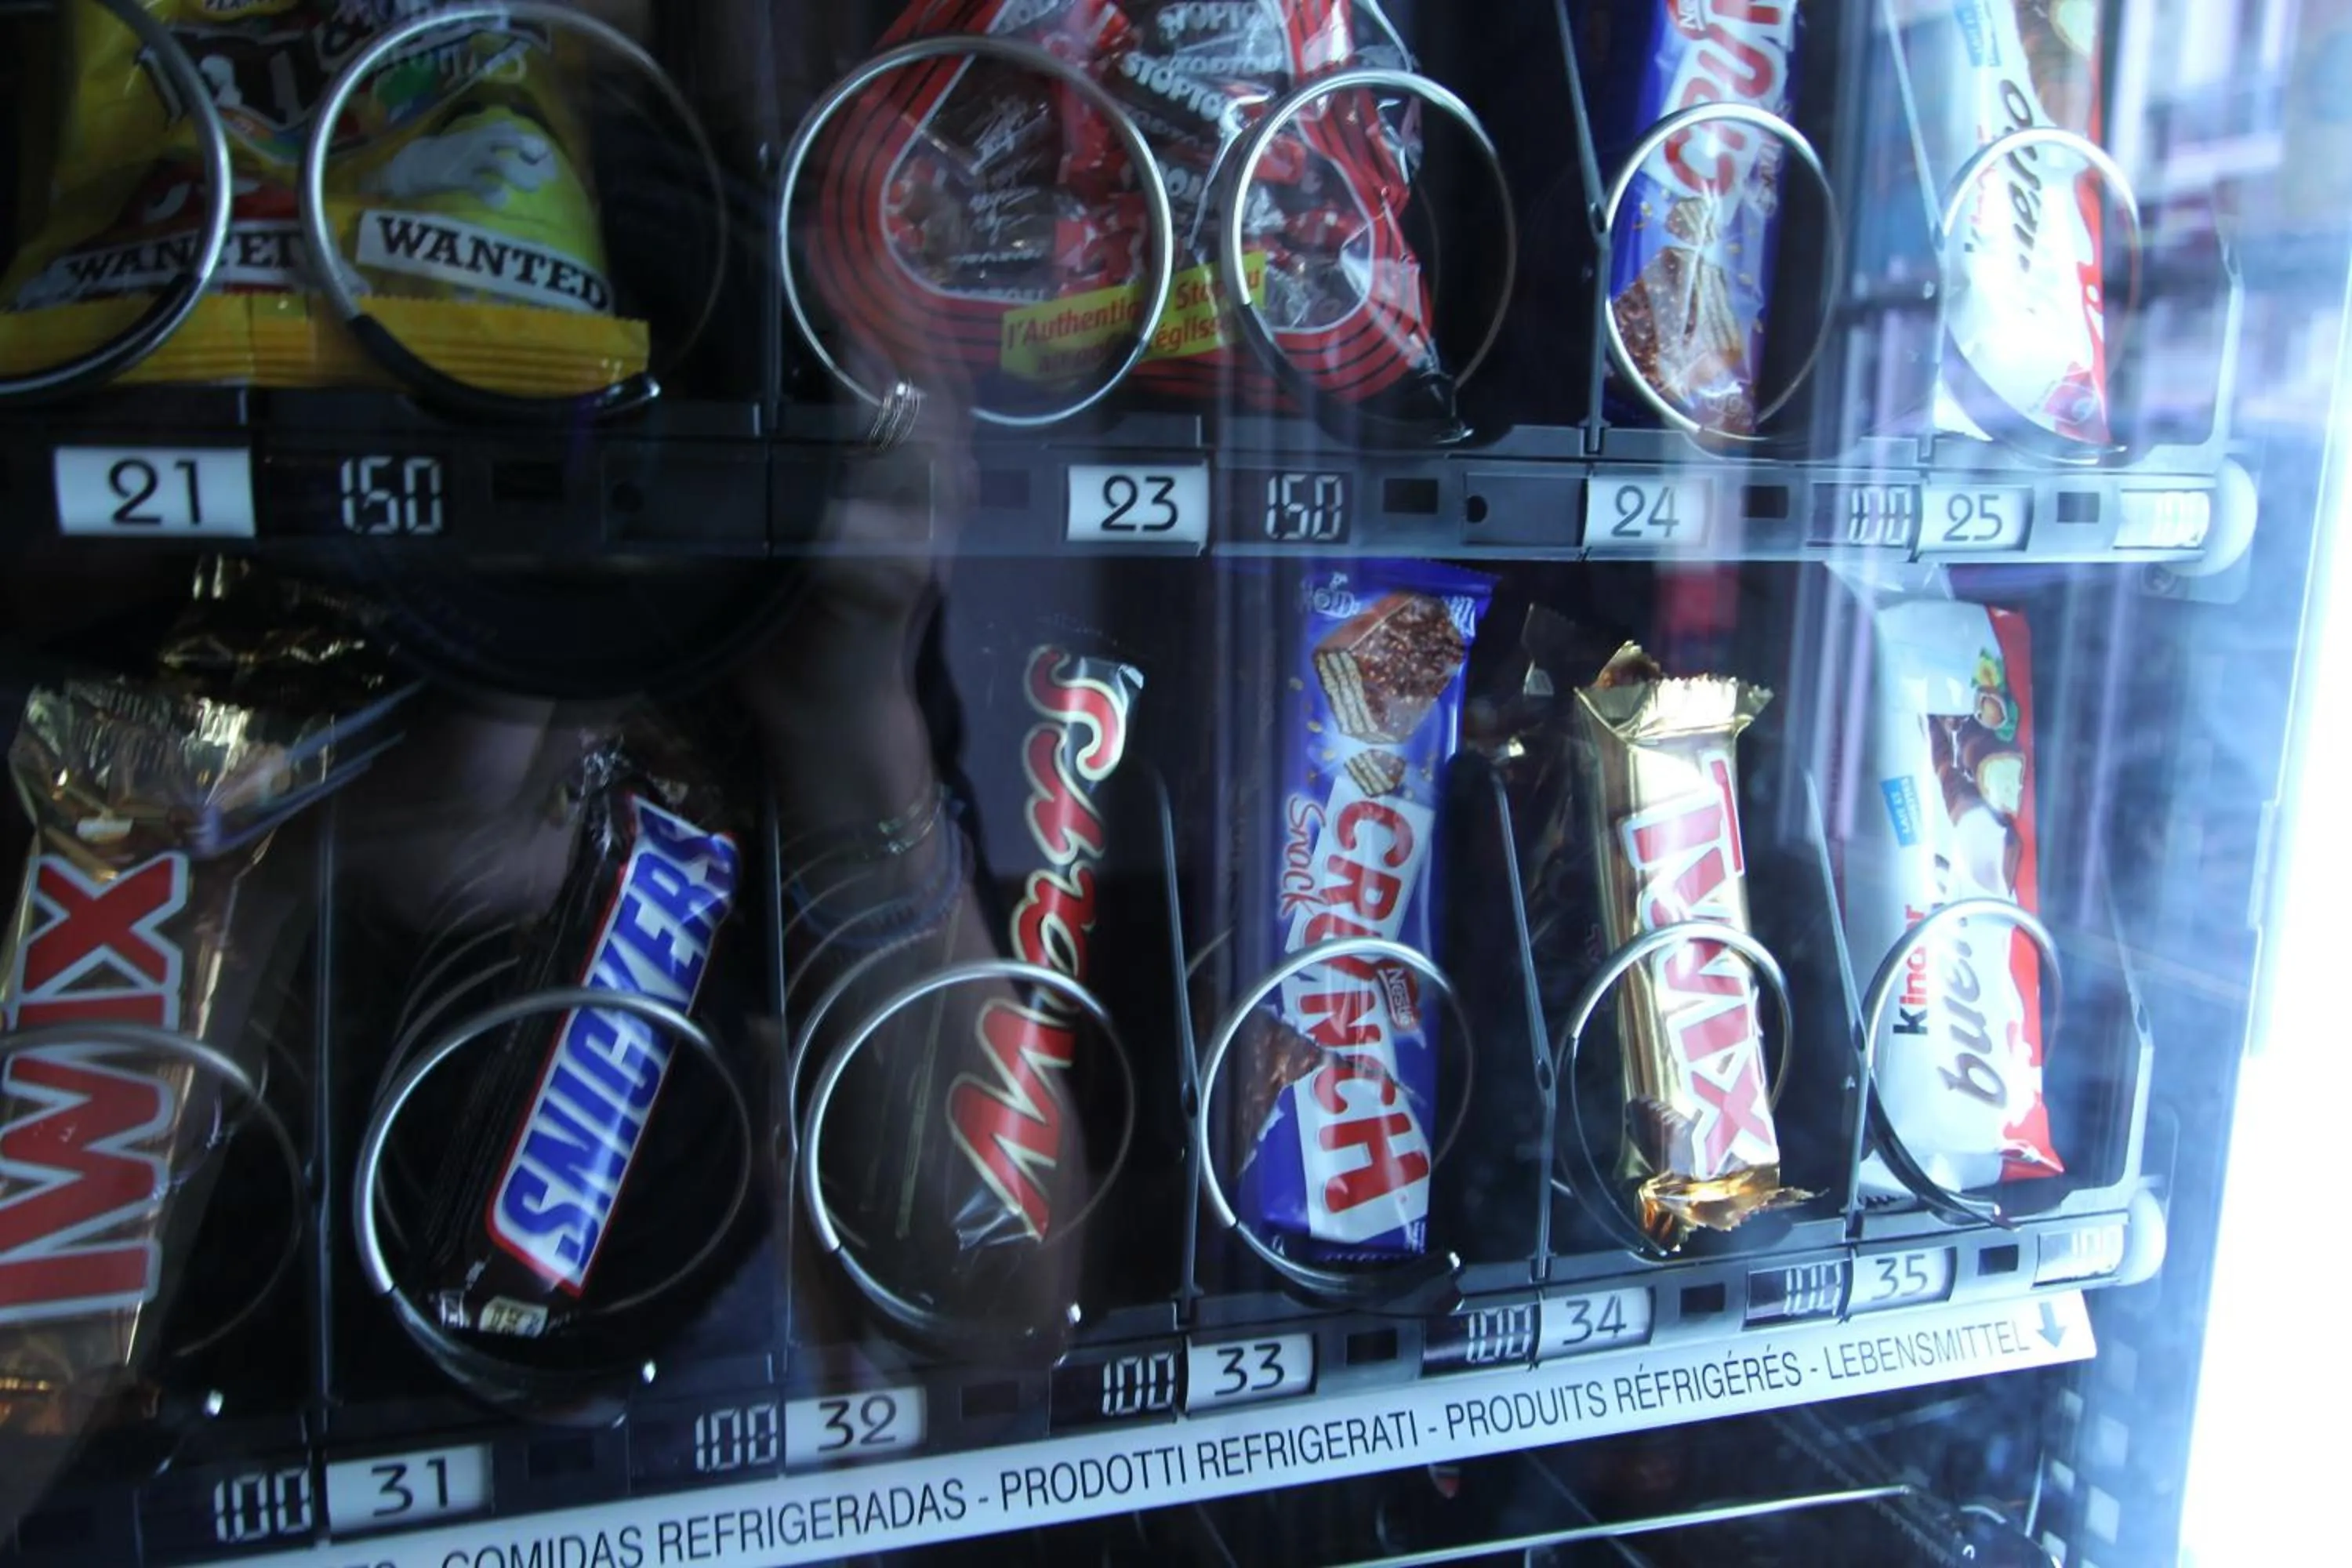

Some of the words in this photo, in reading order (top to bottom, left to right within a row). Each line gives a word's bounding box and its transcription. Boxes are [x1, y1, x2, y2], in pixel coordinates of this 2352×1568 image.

[1122, 50, 1228, 121] STOPTO
[64, 230, 304, 283] WANE
[376, 216, 609, 310] WANTED
[1007, 296, 1145, 350] l'Authenti
[1176, 267, 1260, 311] Stou
[109, 459, 202, 526] 21
[1100, 474, 1179, 532] 23
[1611, 485, 1679, 538] 24
[1943, 494, 2002, 542] 25
[1281, 797, 1327, 916] Snack
[1893, 905, 1927, 1035] kinr
[1298, 800, 1430, 1214] CRUNCH
[503, 808, 737, 1272] SNICKERS
[1871, 1254, 1928, 1300] 35
[1563, 1295, 1626, 1345] 34
[1214, 1341, 1284, 1396] 33
[659, 1480, 967, 1564] REFRIGERADAS
[1000, 1446, 1185, 1511] PRODOTTI
[1200, 1411, 1418, 1482] REFRIGERATI
[1446, 1382, 1607, 1440] PRODUITS
[1616, 1350, 1802, 1414] RÉFRIGÉRÉS
[1828, 1319, 2031, 1380] LEBENSMITTEL
[818, 1394, 896, 1451] 32
[370, 1456, 448, 1517] 31
